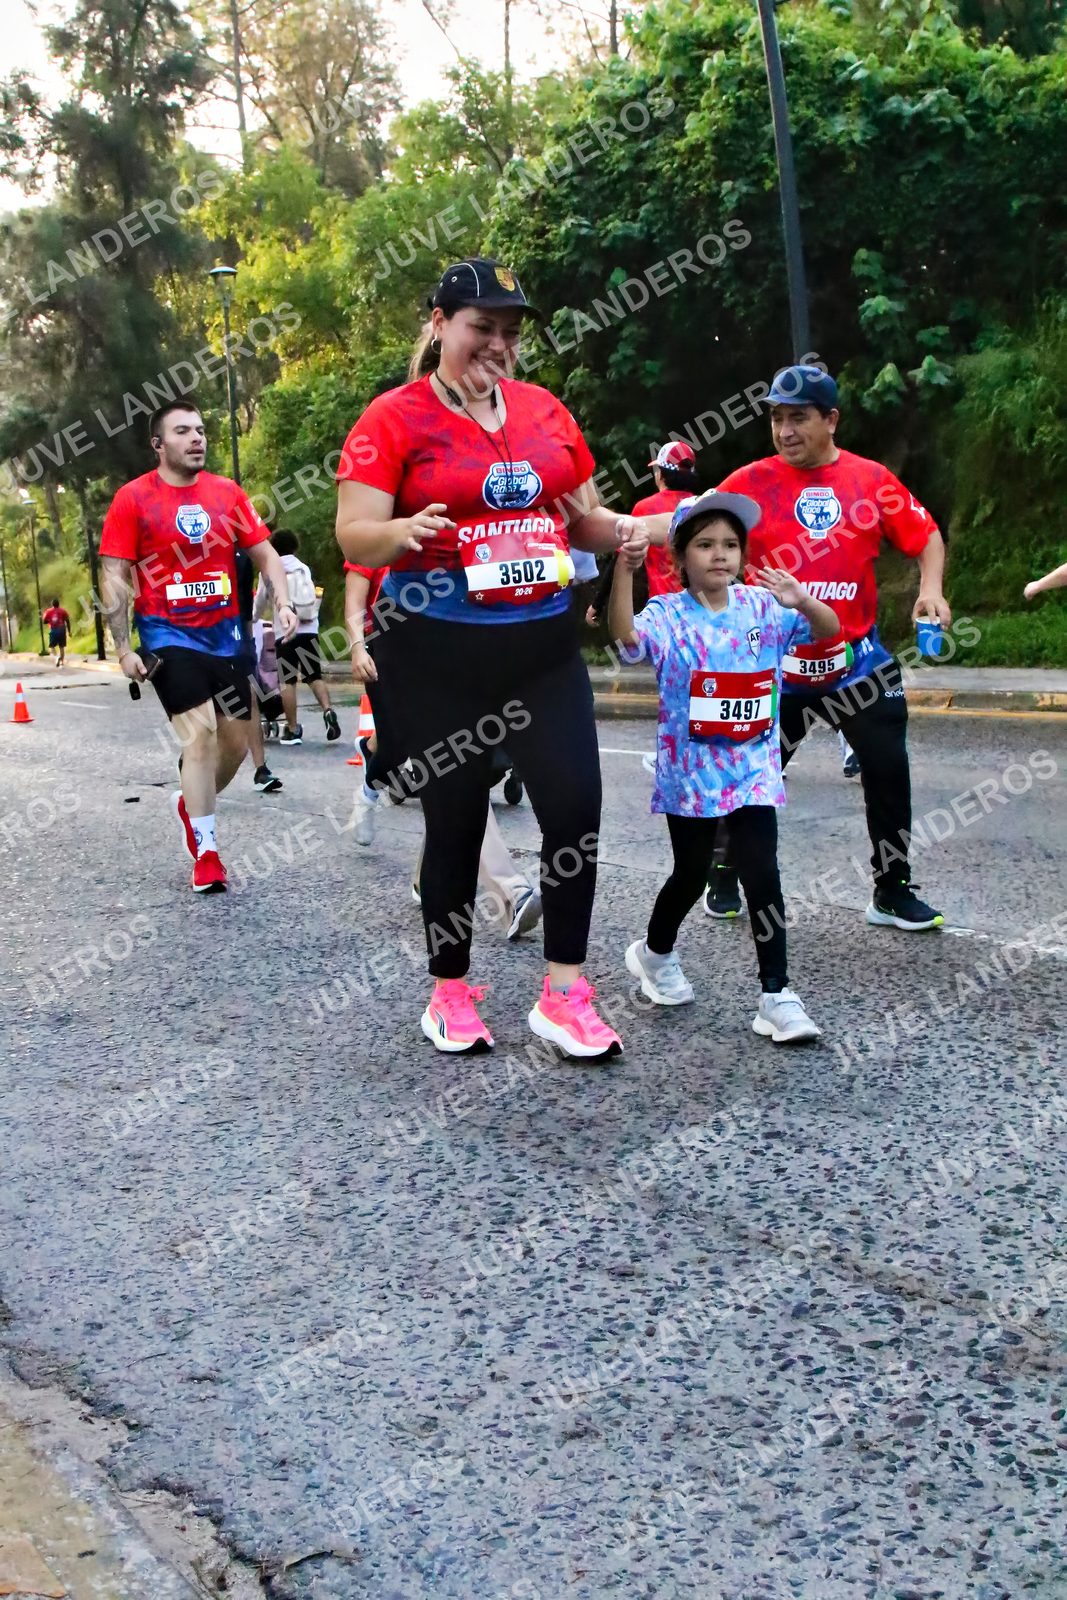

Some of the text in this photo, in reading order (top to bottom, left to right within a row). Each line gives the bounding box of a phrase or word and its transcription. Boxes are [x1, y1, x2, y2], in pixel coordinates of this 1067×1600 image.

[457, 517, 556, 548] SANTIAGO
[499, 559, 546, 586] 3502
[184, 581, 216, 597] 17620
[799, 581, 858, 601] NTIAGO
[799, 657, 835, 675] 3495
[720, 699, 760, 721] 3497
